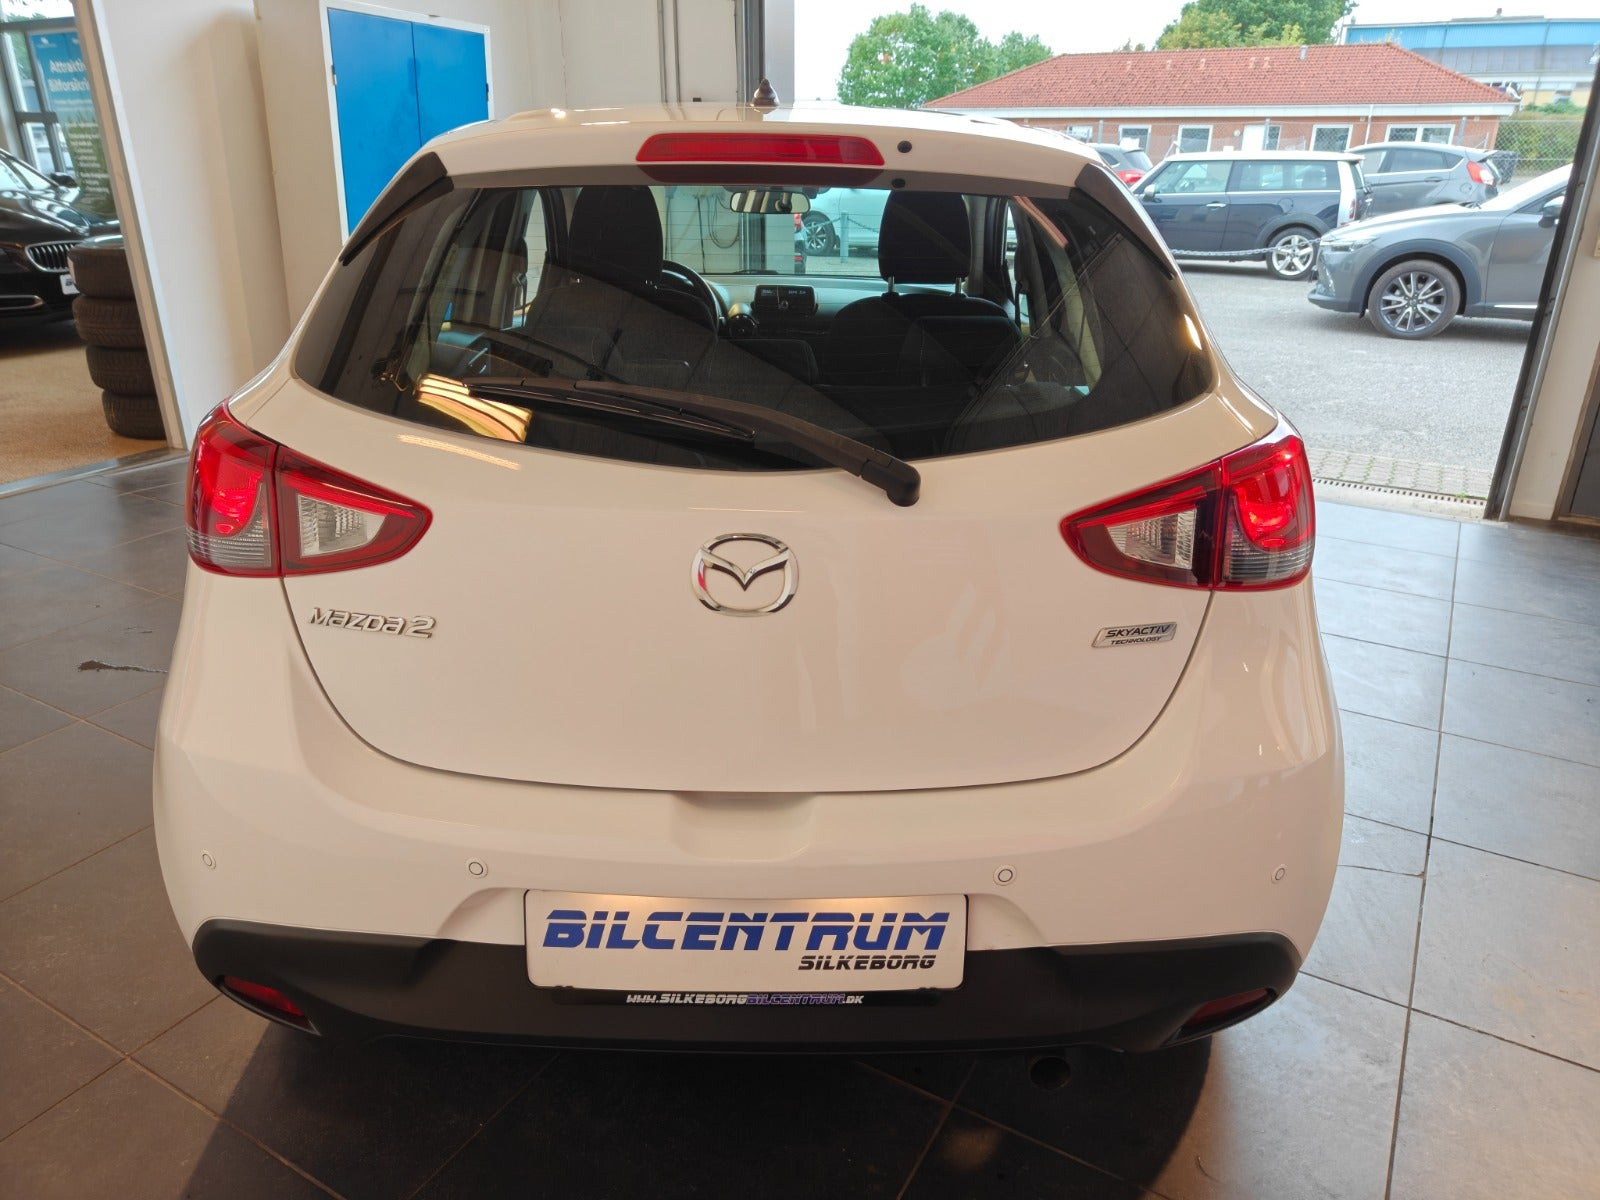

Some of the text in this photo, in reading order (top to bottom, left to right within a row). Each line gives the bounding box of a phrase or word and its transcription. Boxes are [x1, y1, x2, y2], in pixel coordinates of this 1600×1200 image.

[1105, 624, 1171, 637] SKYACTIV
[1111, 637, 1161, 645] TECHNOLOGY
[542, 909, 950, 952] BILCENTRUM
[798, 954, 937, 971] SILKEBORG
